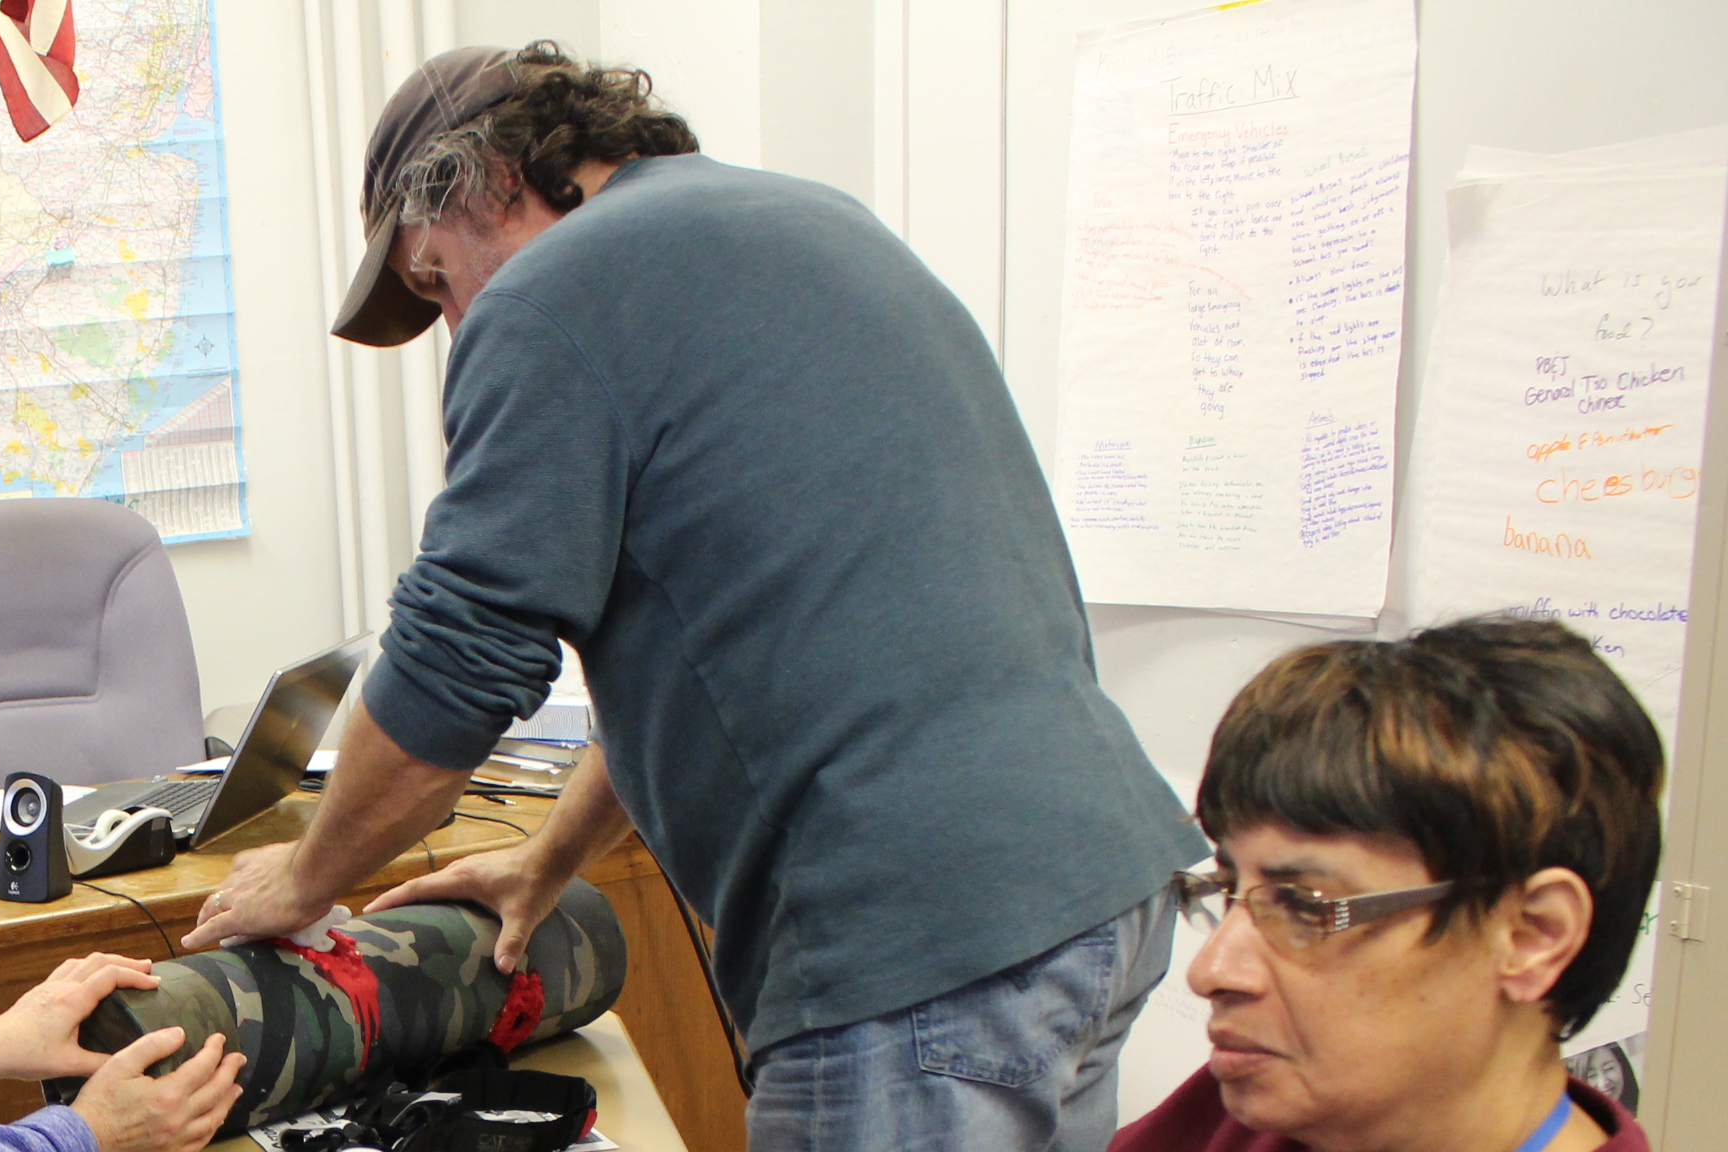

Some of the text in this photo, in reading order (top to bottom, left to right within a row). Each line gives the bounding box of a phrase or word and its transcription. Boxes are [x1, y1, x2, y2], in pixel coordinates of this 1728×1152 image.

[1159, 76, 1236, 112] Traffic
[1167, 119, 1289, 148] Emergency Vehicles
[1540, 268, 1606, 297] What
[1622, 271, 1643, 289] is
[1615, 361, 1685, 392] Chicken
[1502, 514, 1592, 560] banana
[1568, 601, 1599, 618] with
[1608, 601, 1689, 622] chocolate
